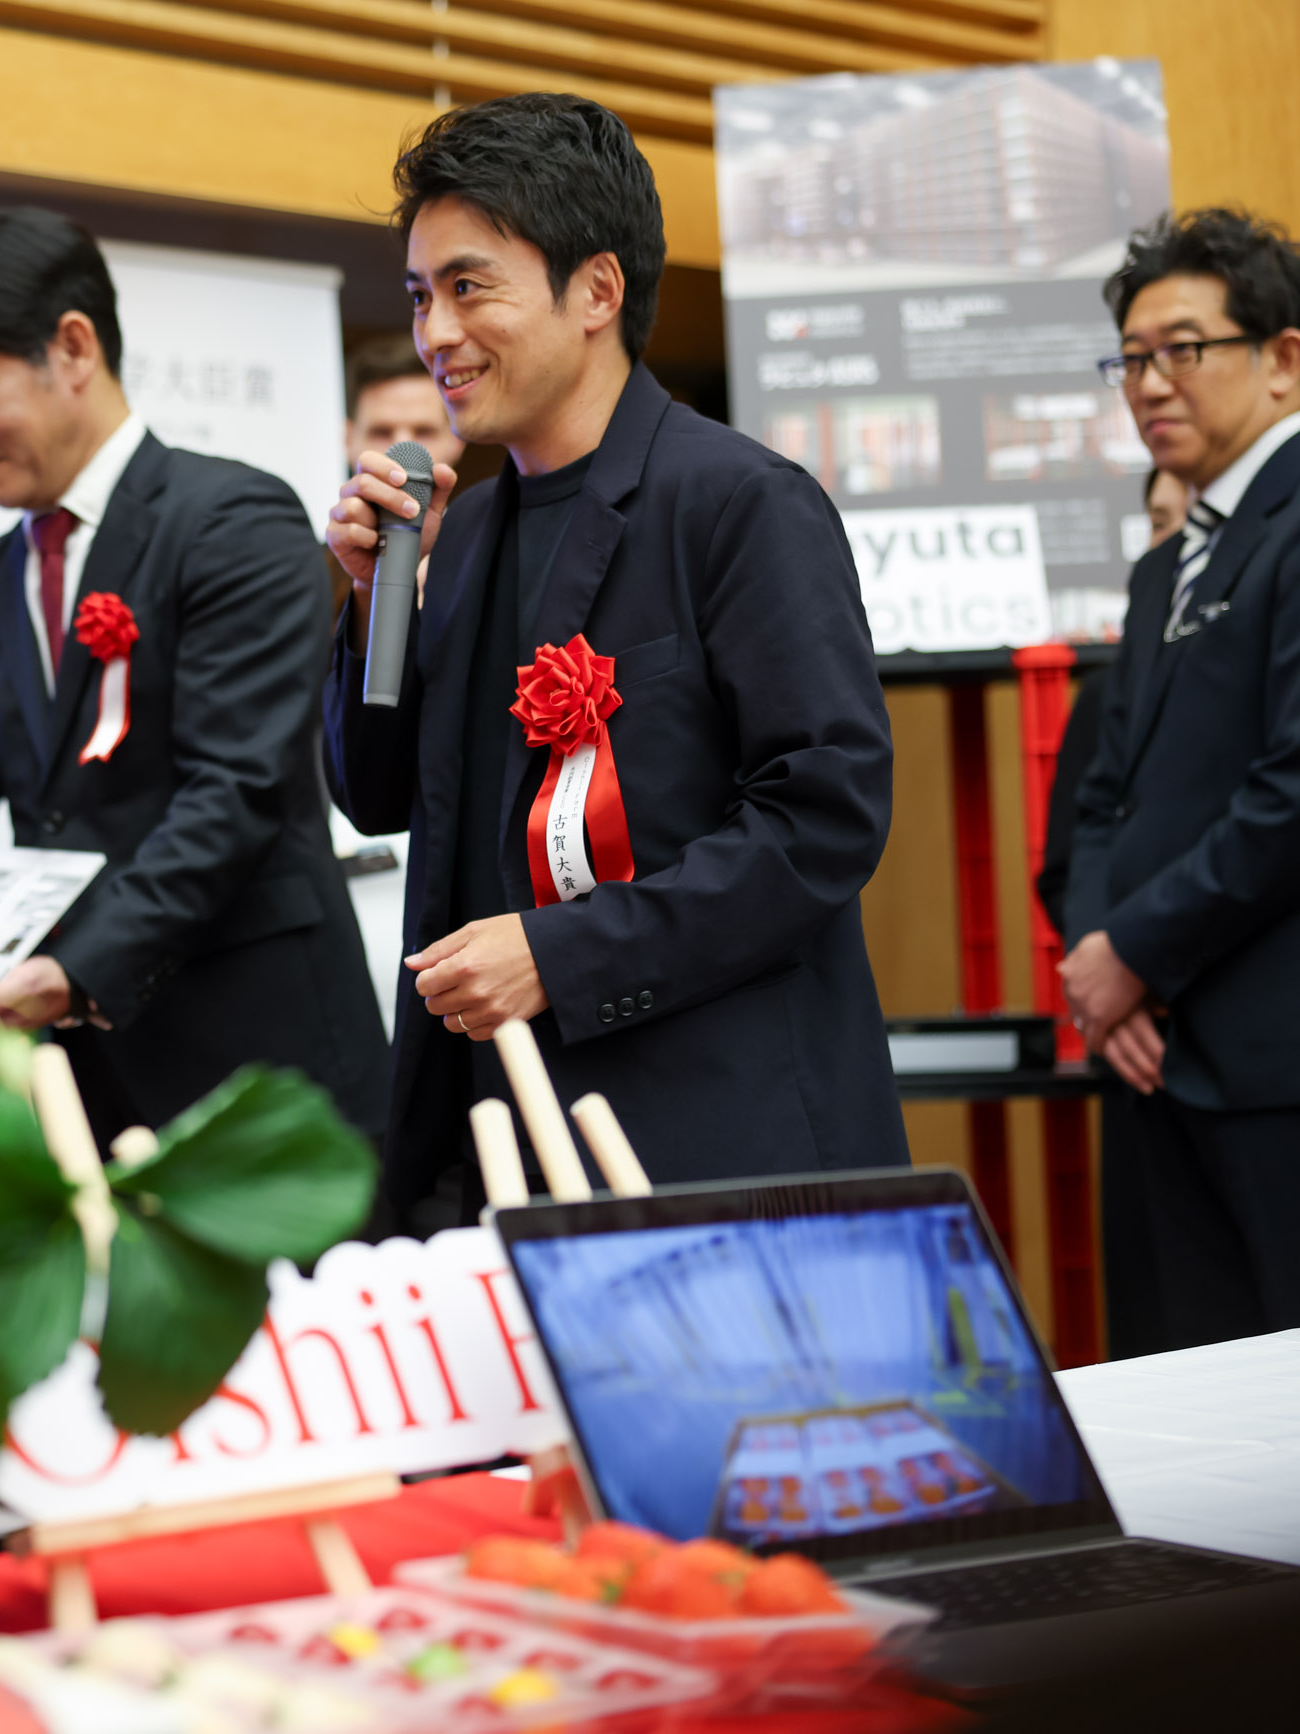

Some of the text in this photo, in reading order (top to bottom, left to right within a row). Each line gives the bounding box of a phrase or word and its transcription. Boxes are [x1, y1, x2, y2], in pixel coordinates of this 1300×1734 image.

[850, 519, 1025, 580] yuta
[552, 814, 577, 892] 古賀大貴
[3, 1284, 471, 1488] Oshii
